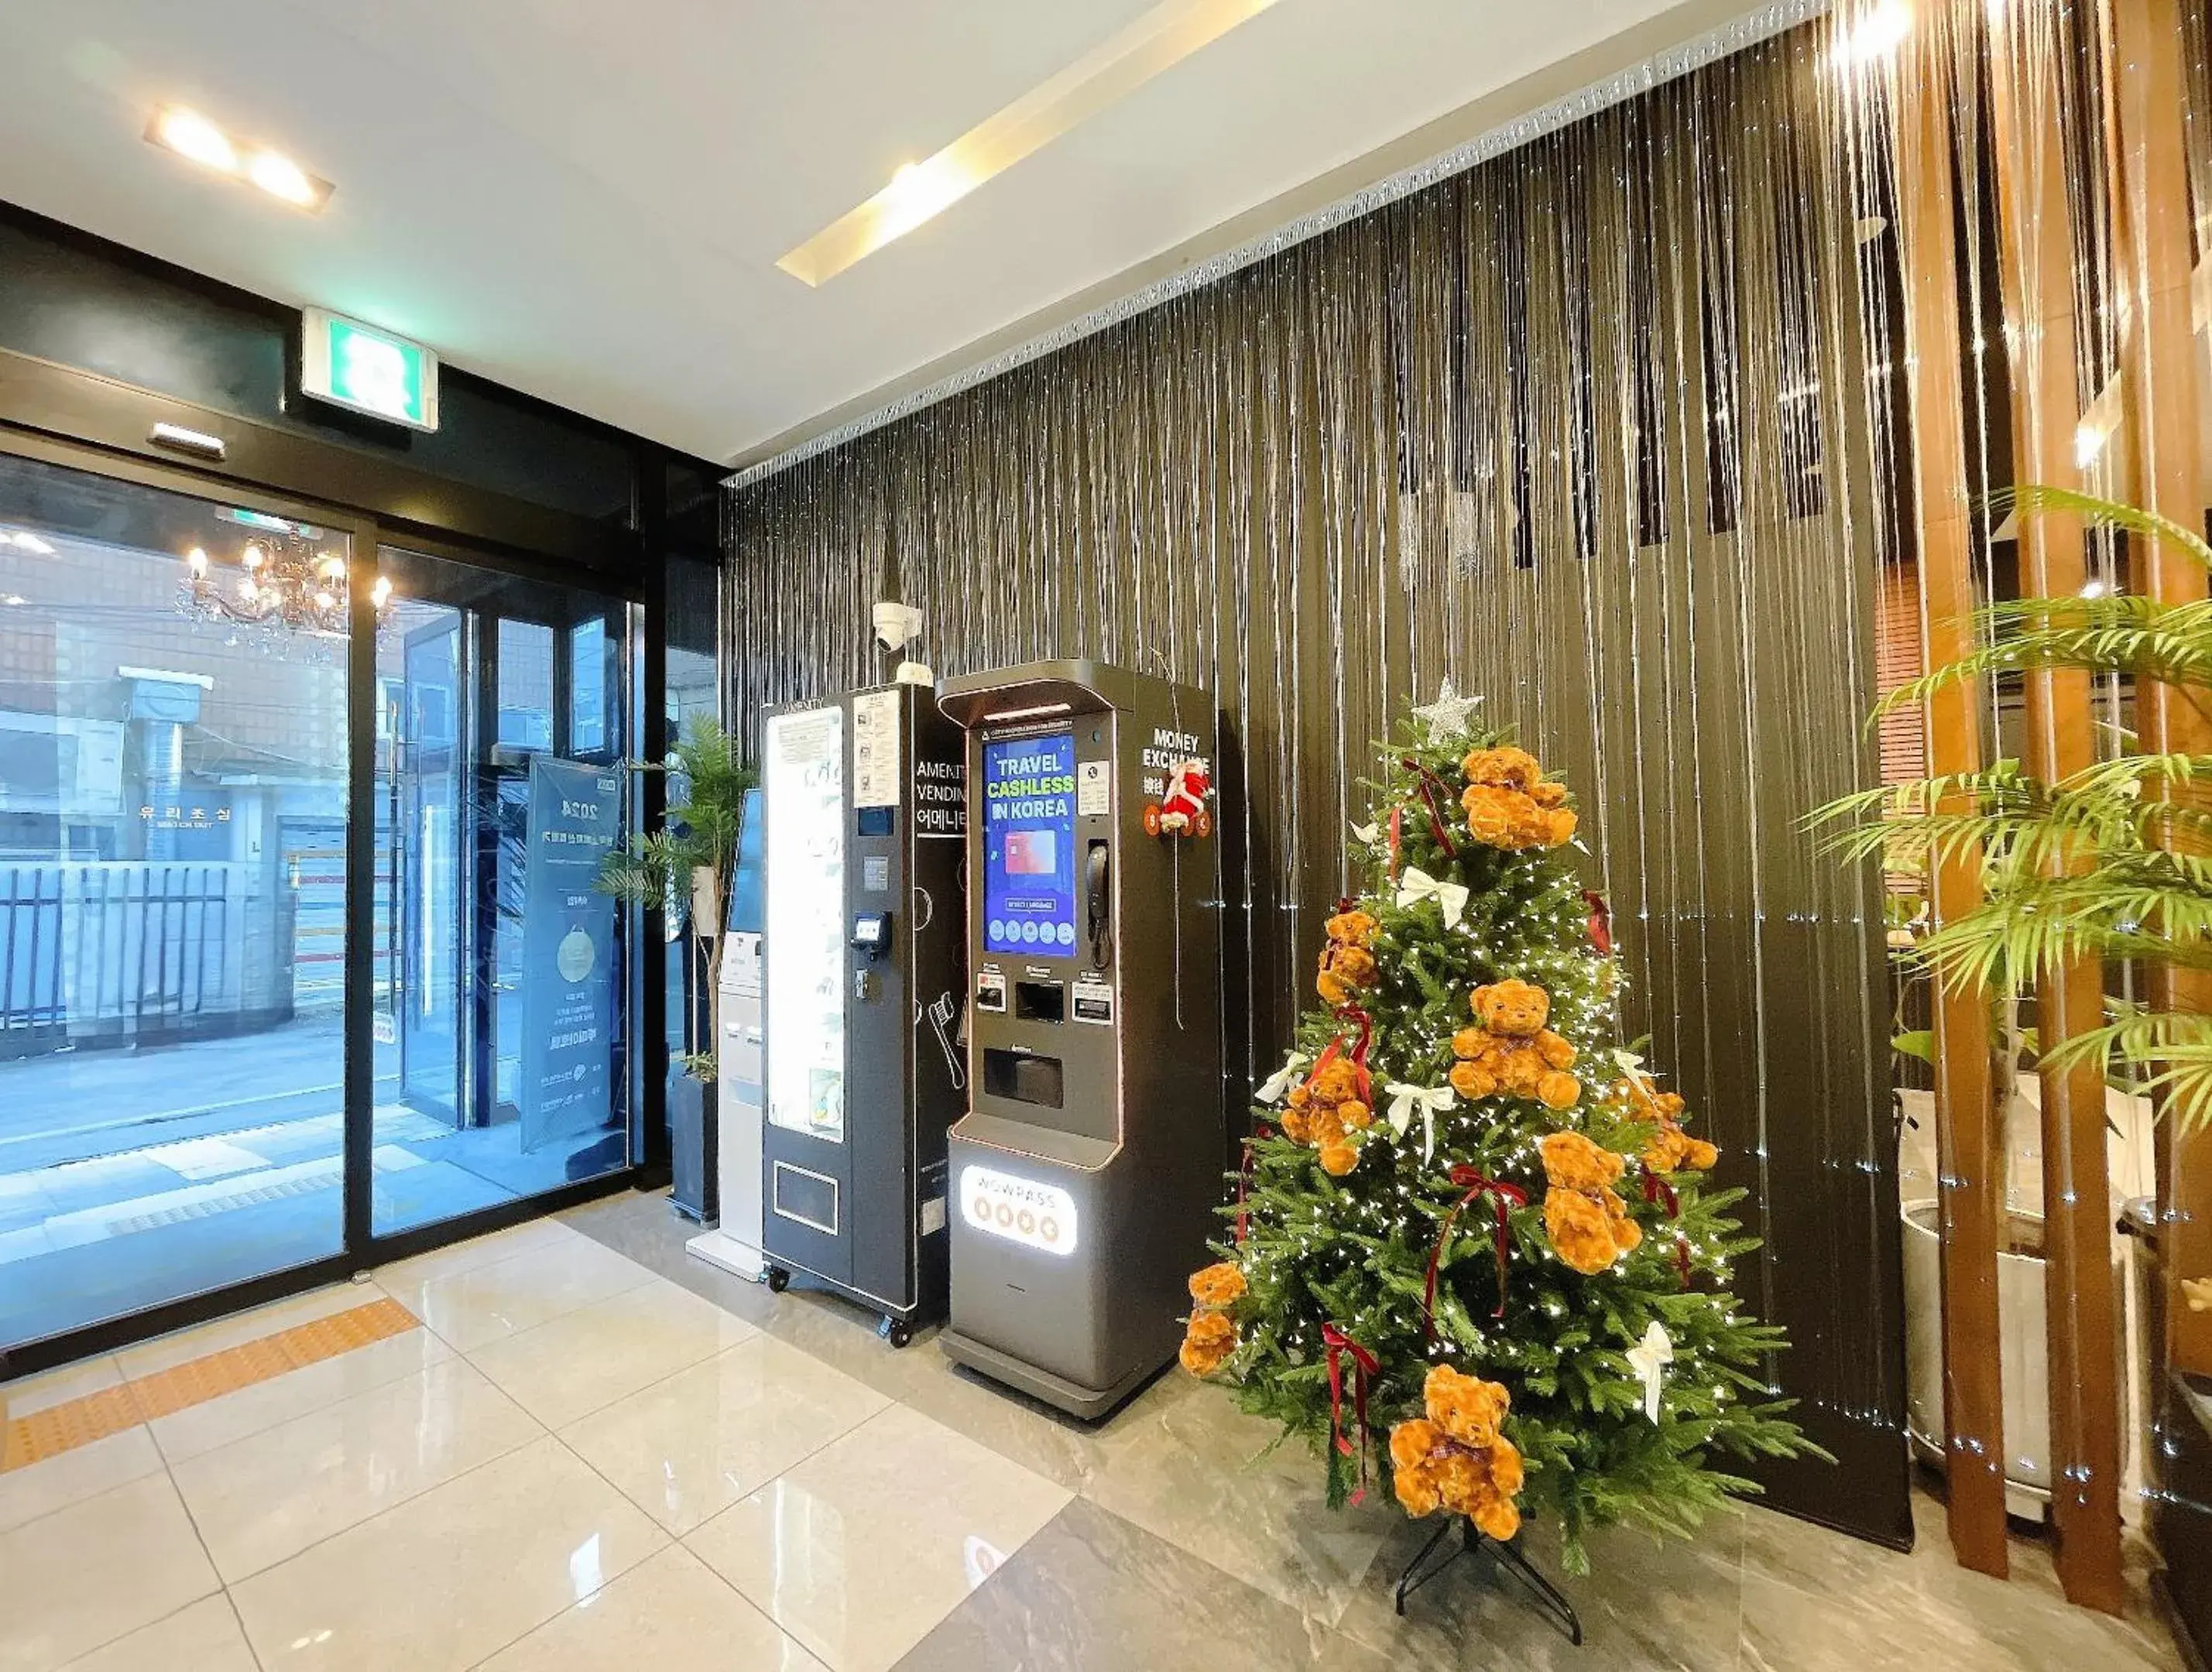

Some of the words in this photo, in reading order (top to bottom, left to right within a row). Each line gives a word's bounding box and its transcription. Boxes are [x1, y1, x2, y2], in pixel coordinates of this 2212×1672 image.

[1154, 728, 1199, 752] MONEY
[996, 753, 1062, 776] TRAVEL
[987, 775, 1075, 798] CASHLESS
[992, 803, 1008, 820] IN
[1011, 798, 1068, 819] KOREA
